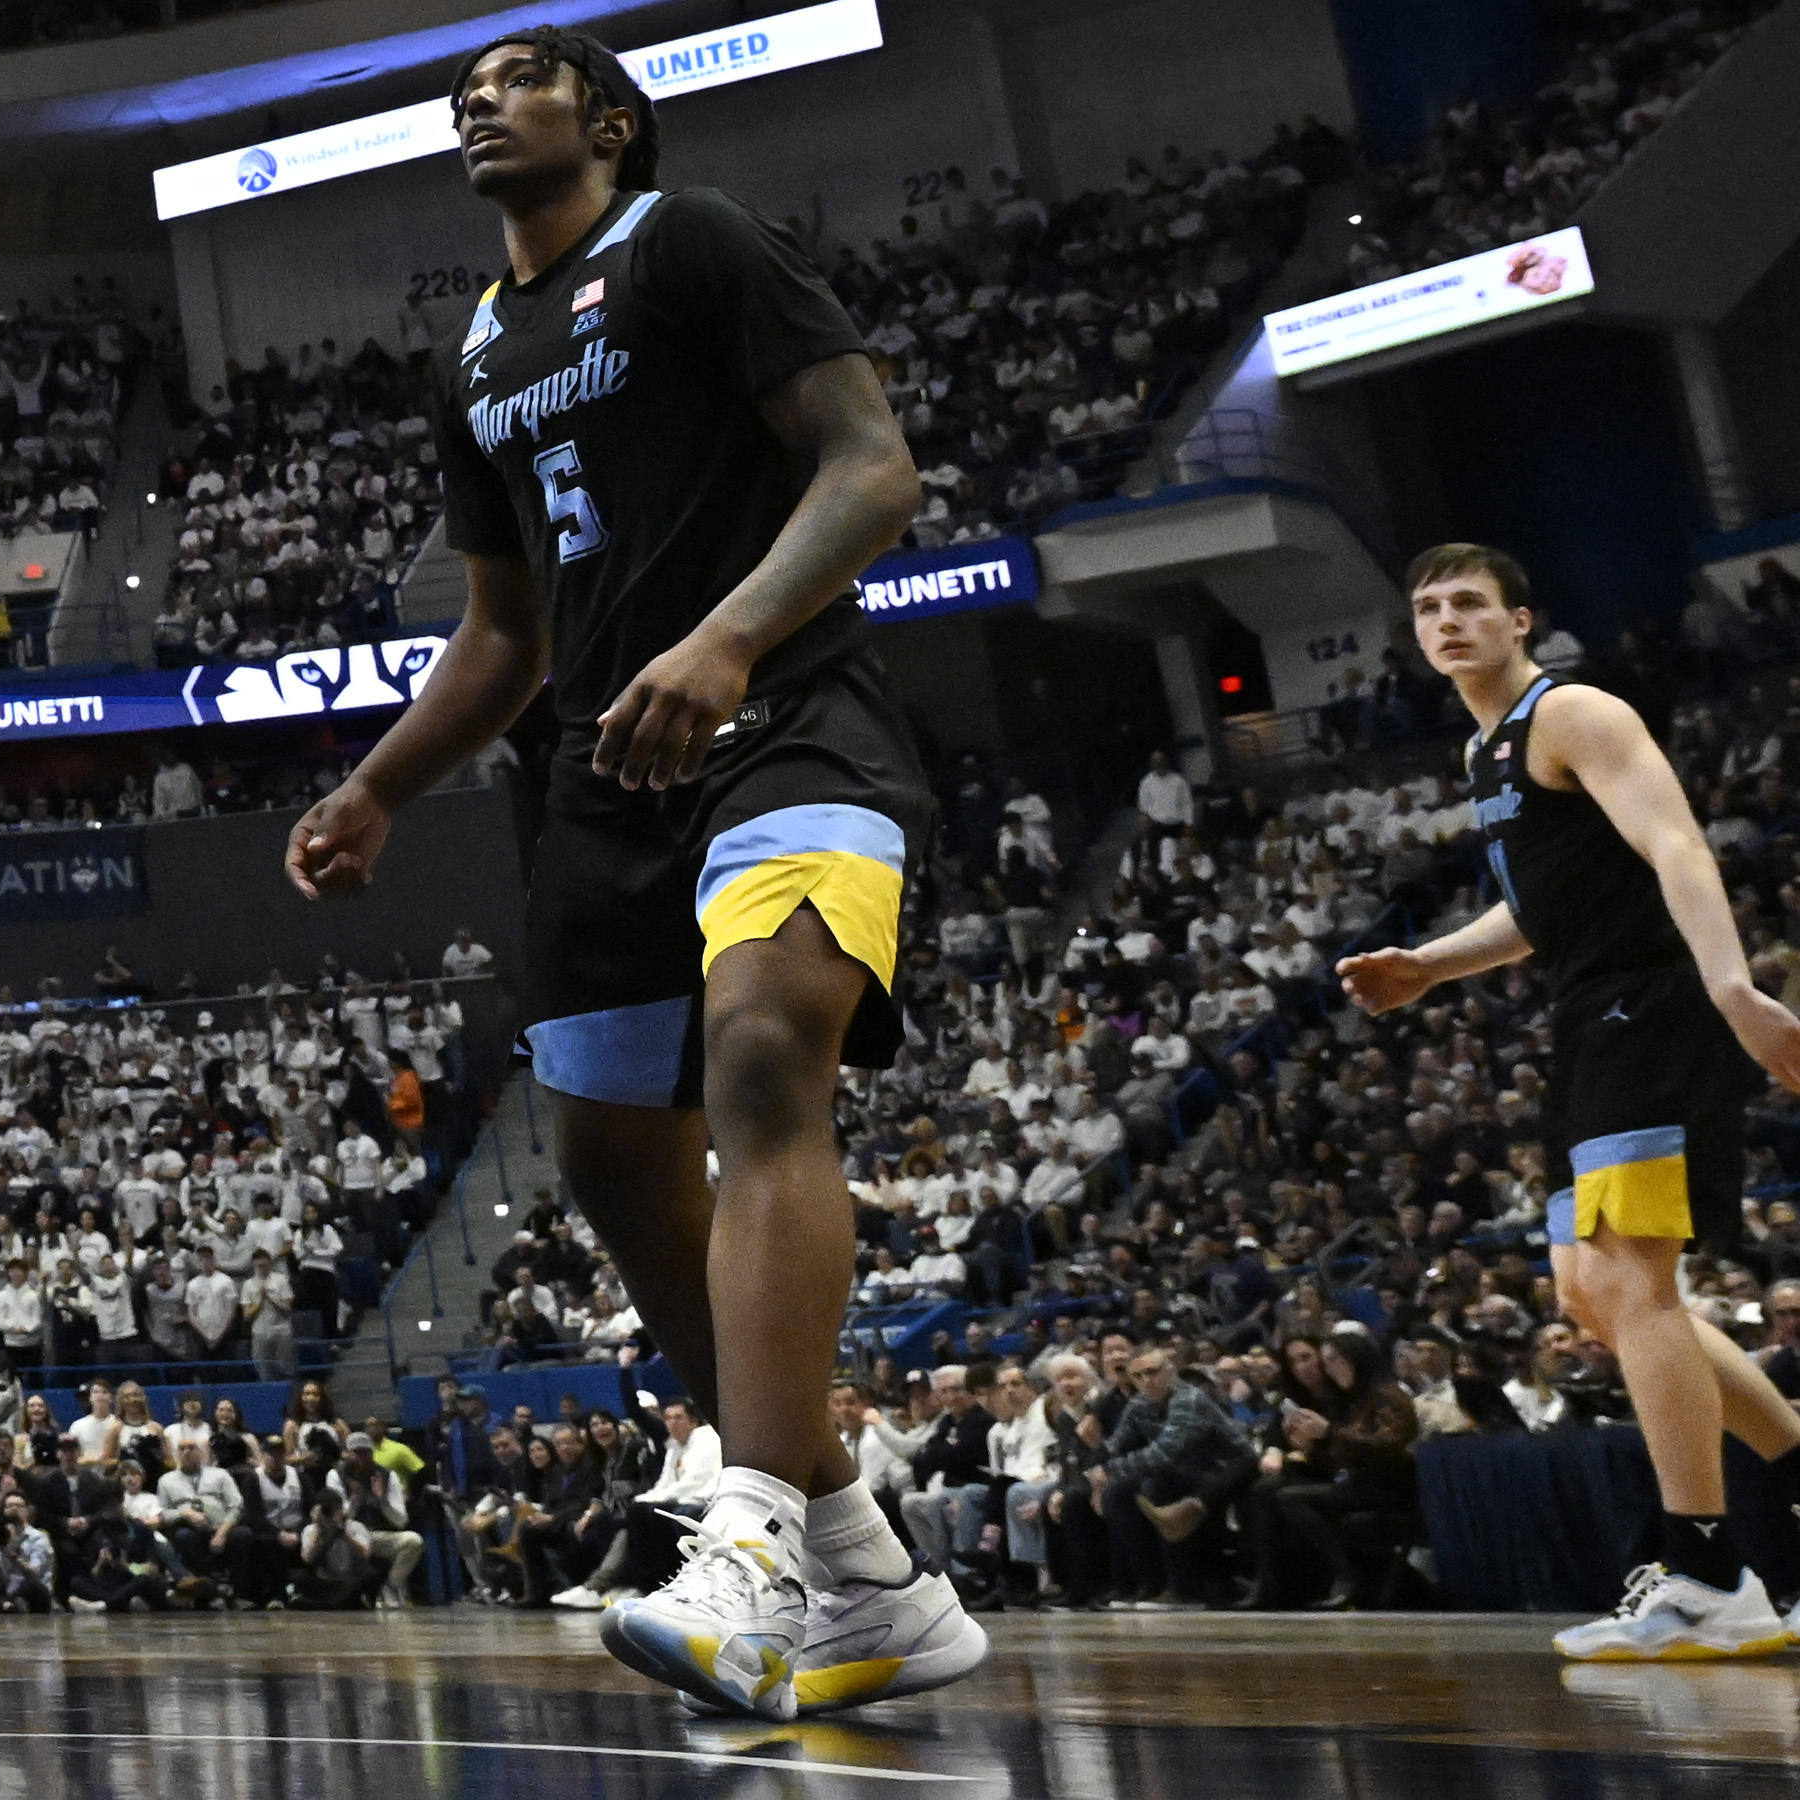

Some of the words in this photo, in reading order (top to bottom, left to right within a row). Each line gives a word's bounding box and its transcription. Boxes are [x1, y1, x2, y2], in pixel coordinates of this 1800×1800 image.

[645, 32, 770, 80] UNITED
[409, 265, 470, 299] 228
[467, 336, 631, 454] Marquette
[532, 439, 612, 565] 5
[1306, 632, 1361, 664] 124
[738, 708, 758, 724] 46
